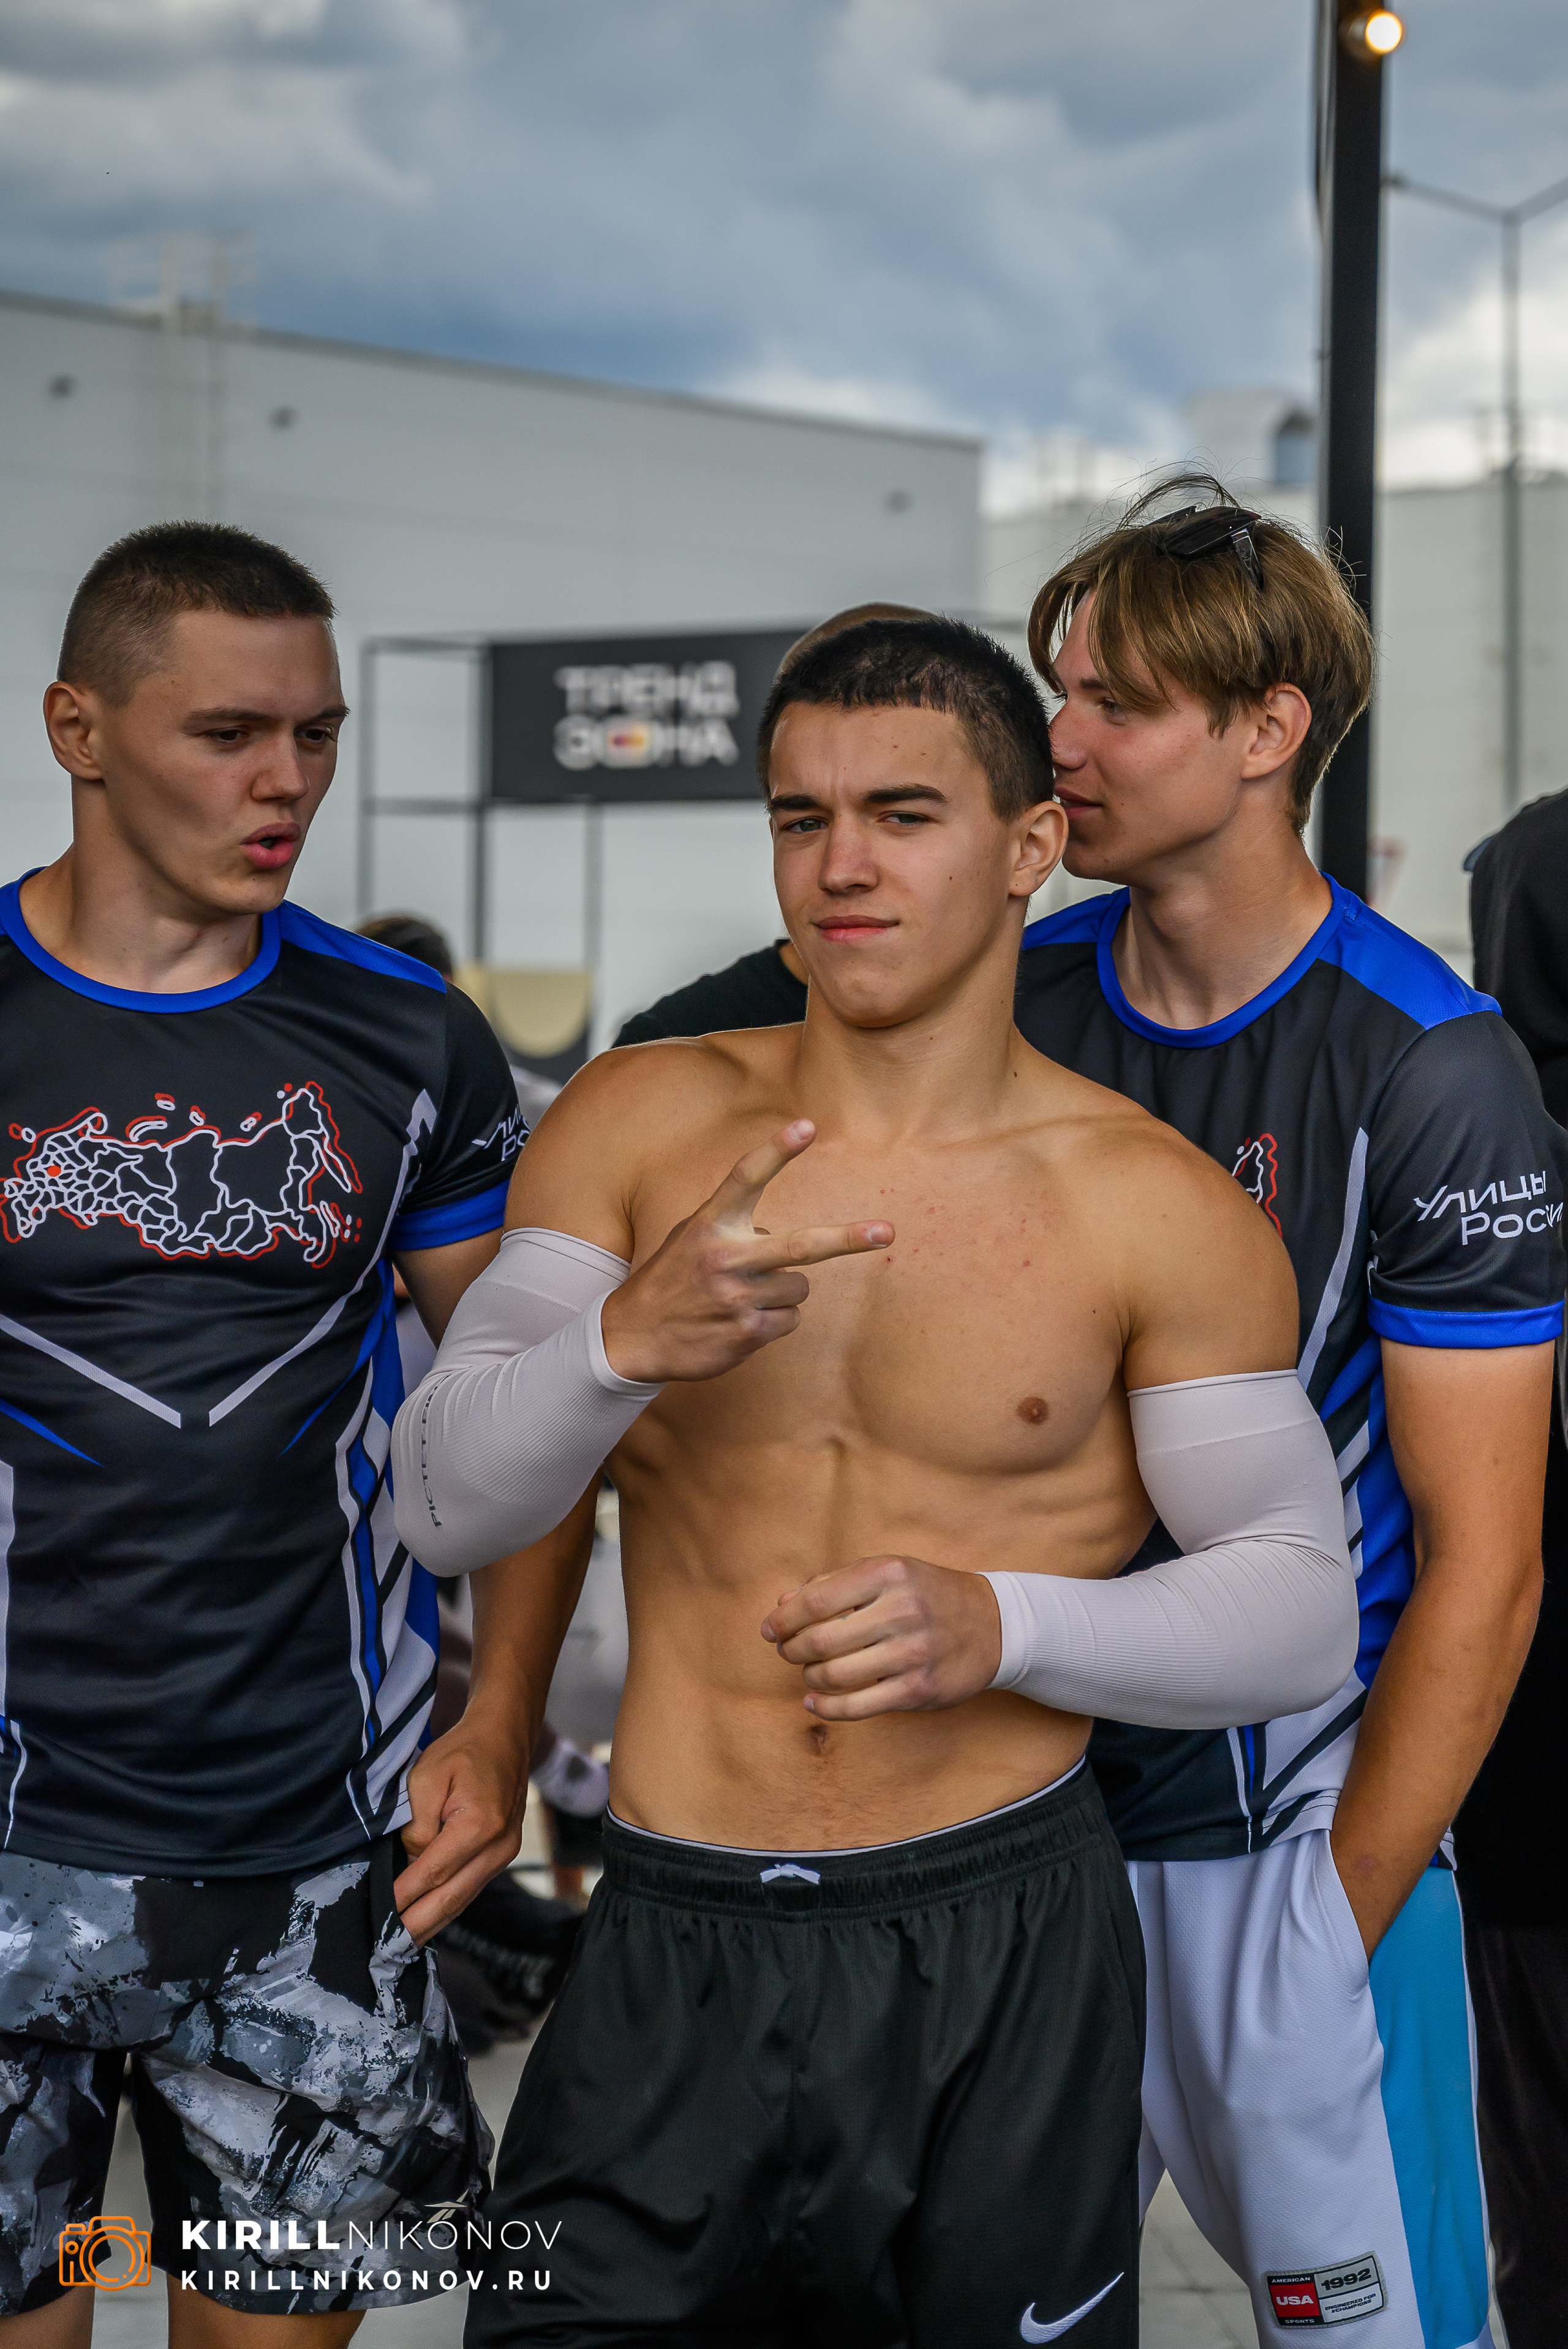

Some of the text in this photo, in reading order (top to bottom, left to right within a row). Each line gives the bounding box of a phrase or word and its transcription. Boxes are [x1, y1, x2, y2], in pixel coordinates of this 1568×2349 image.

[1321, 2268, 1372, 2291] 1992
[1276, 2295, 1314, 2306] USA
[1325, 2298, 1363, 2310] ENGINEERED
